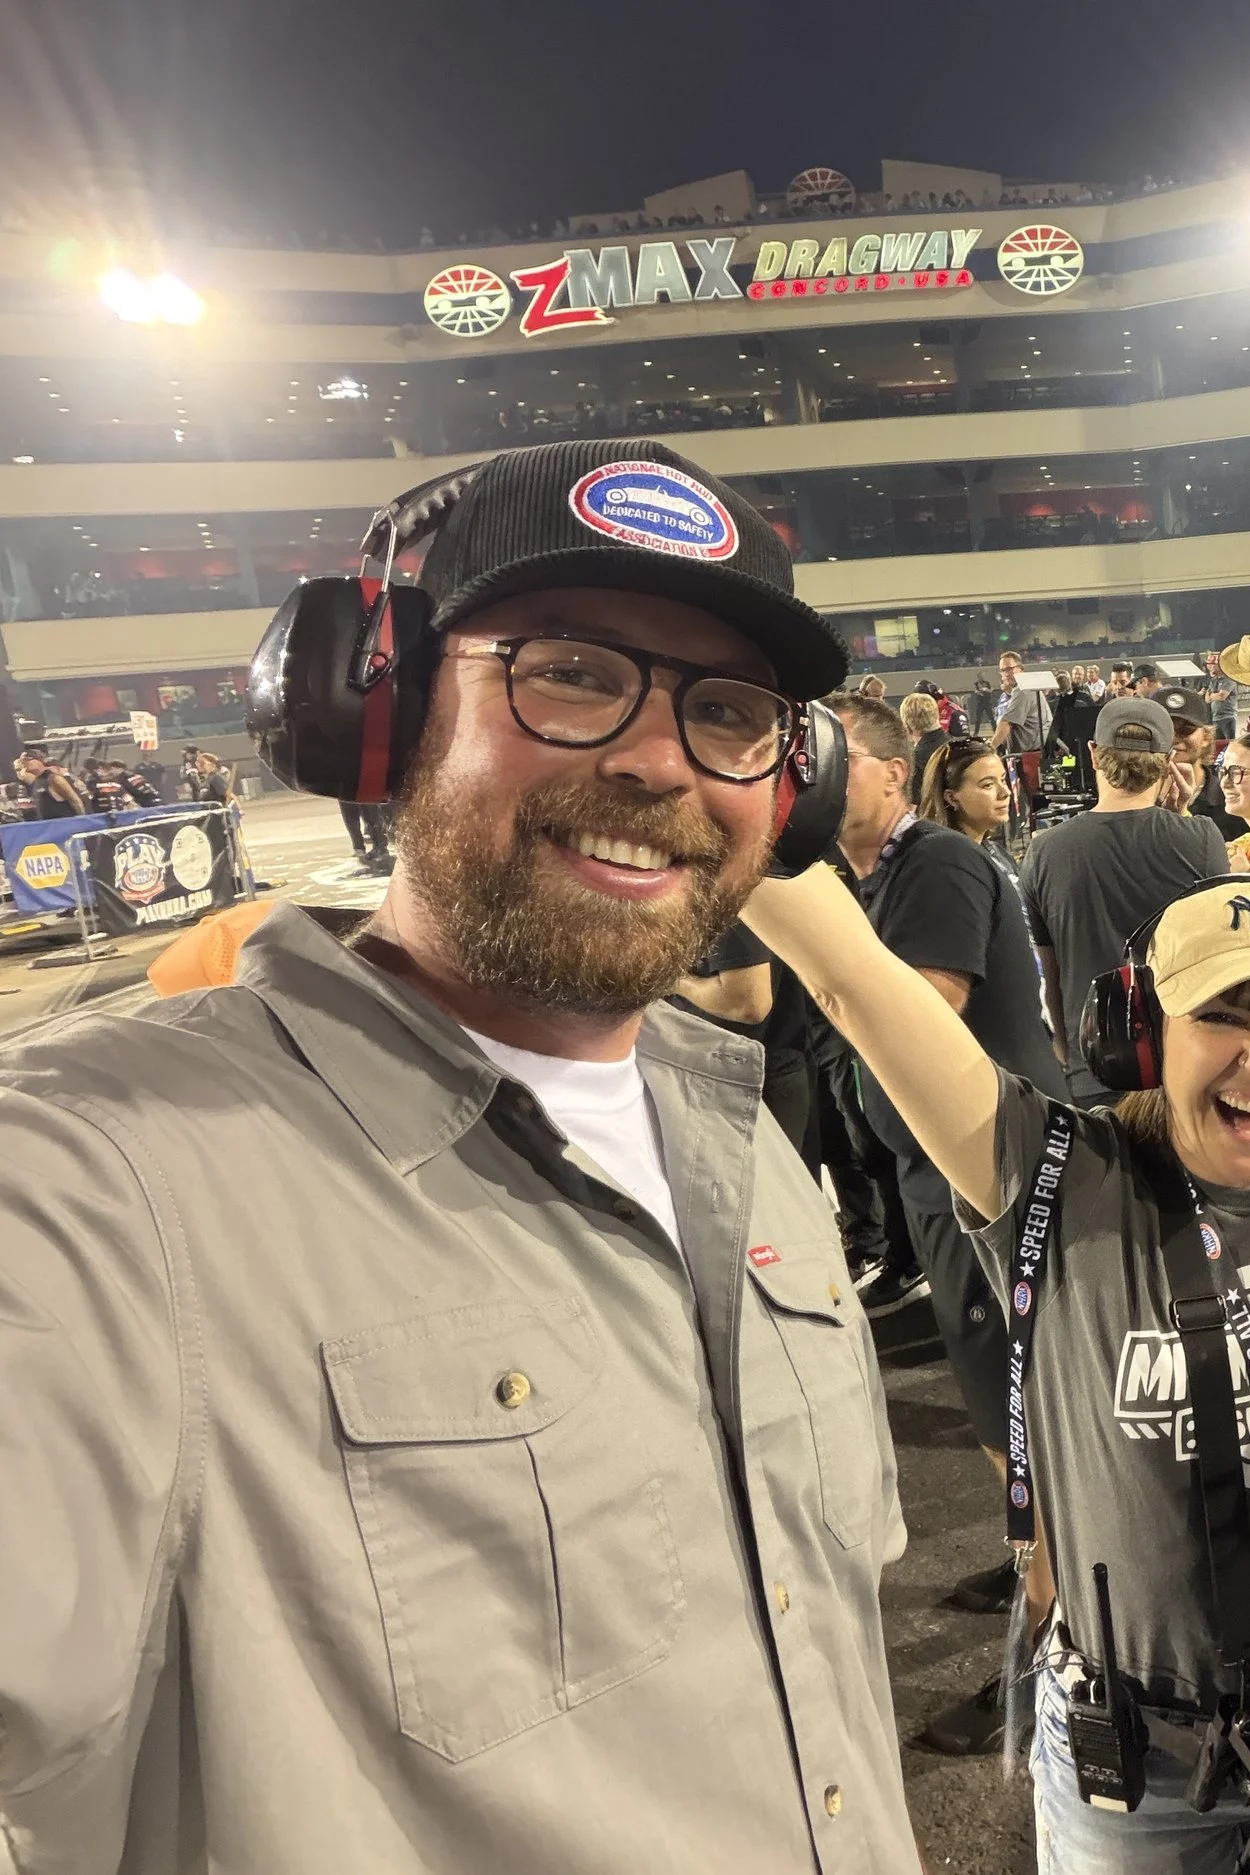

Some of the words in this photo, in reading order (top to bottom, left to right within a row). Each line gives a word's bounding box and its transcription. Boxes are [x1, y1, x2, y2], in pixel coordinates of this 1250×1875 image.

[509, 237, 744, 338] ZMAX
[753, 228, 983, 282] DRAGWAY
[750, 273, 892, 300] CONCORD
[913, 269, 973, 288] USA
[604, 462, 662, 476] NATIONAL
[665, 468, 689, 484] HOT
[602, 502, 661, 523] DEDICATED
[662, 515, 677, 527] TO
[678, 519, 714, 541] SAFETY
[616, 529, 699, 556] ASSOCIATION
[24, 855, 64, 878] NAPA
[1046, 1128, 1071, 1161] ALL
[1034, 1163, 1064, 1200] FOR
[1020, 1202, 1051, 1262] SPEED
[1009, 1357, 1024, 1390] ALL
[1009, 1385, 1024, 1421] FOR
[1009, 1419, 1028, 1466] SPEED
